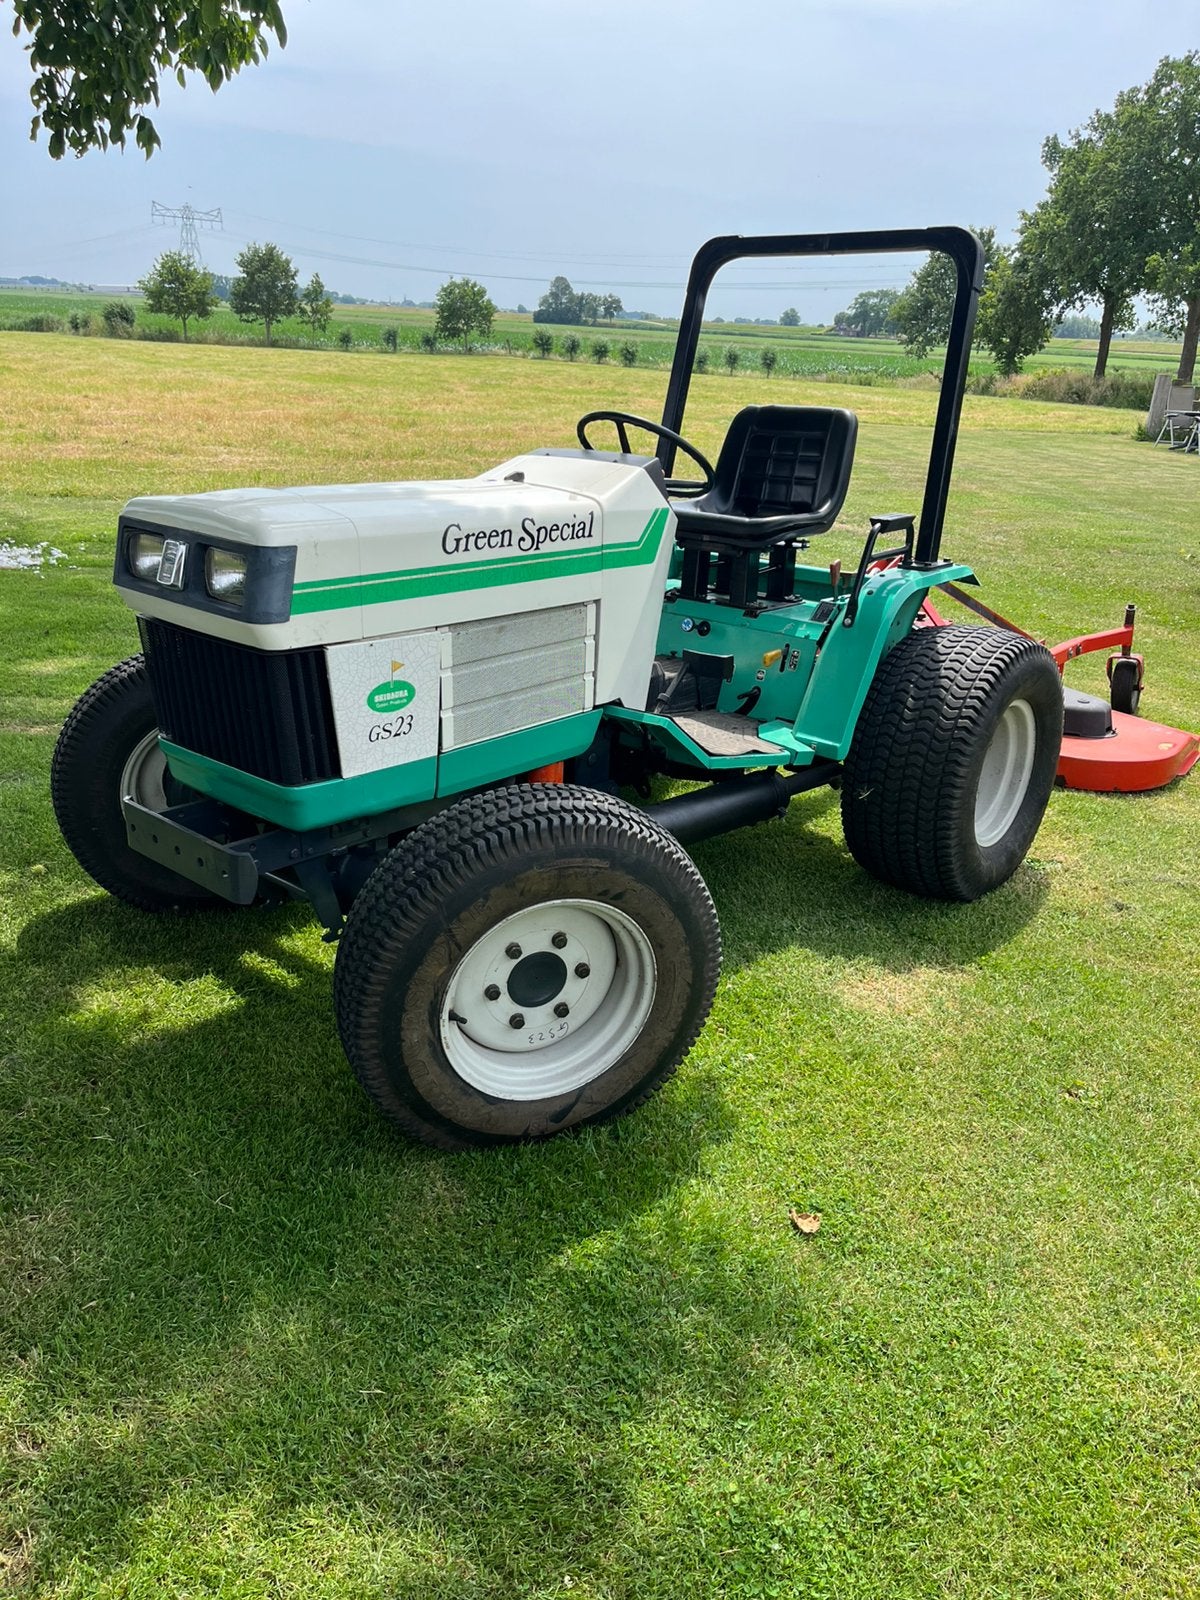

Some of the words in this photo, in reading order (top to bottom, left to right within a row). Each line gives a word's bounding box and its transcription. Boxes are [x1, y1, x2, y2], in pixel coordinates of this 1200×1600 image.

[441, 523, 513, 555] Green
[518, 511, 594, 552] Special
[368, 714, 414, 743] GS23
